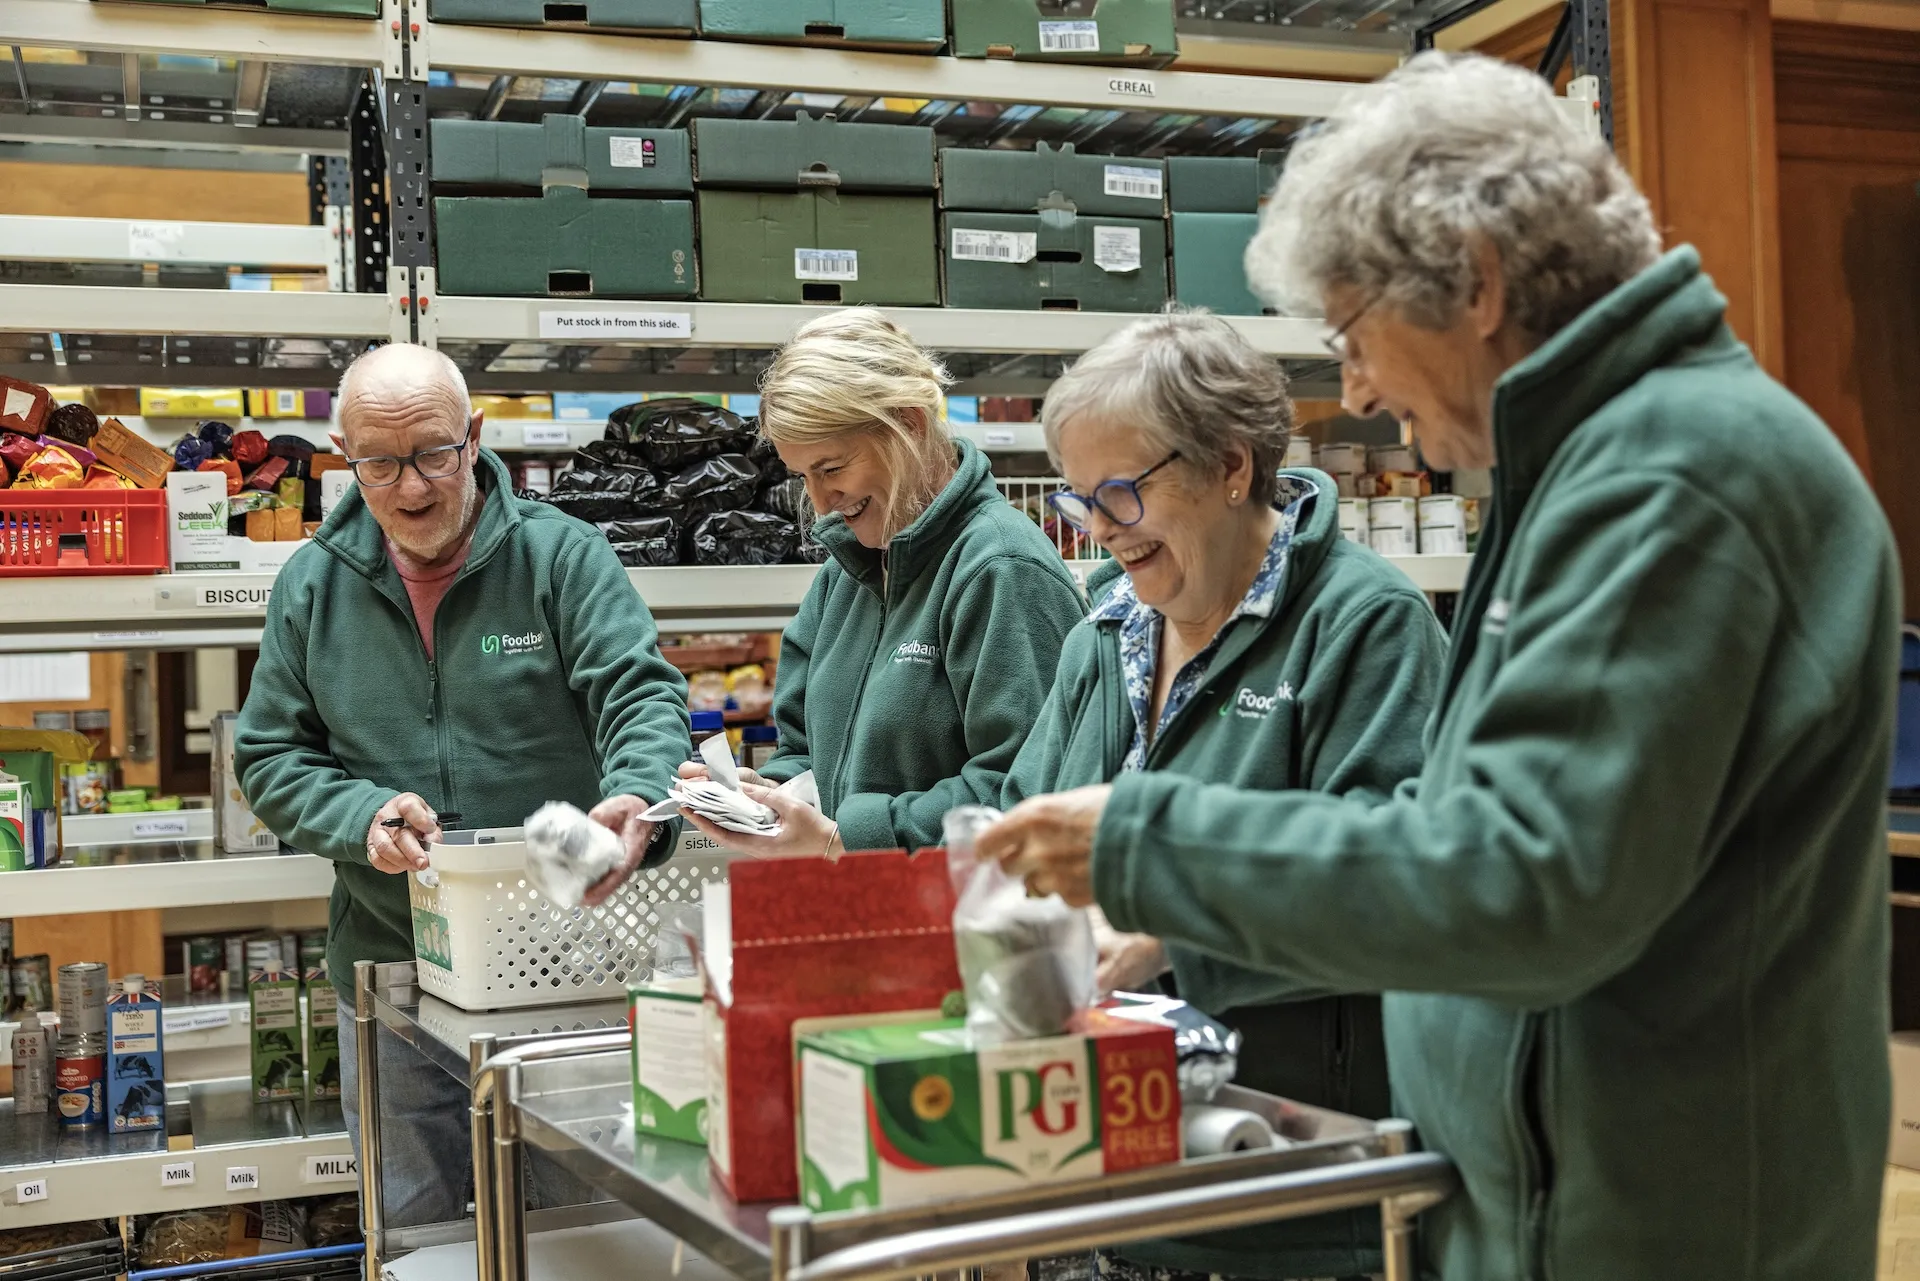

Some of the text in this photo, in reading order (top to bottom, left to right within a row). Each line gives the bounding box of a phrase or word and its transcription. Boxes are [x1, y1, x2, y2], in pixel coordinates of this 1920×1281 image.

[1109, 80, 1153, 95] CEREAL
[557, 317, 680, 329] Put stock in from this side.
[178, 511, 213, 521] Seddons
[205, 589, 272, 604] BISCUI
[502, 631, 544, 647] Foodba
[685, 836, 720, 850] siste
[995, 1060, 1078, 1142] PG
[1106, 1069, 1172, 1126] 30
[1109, 1124, 1174, 1154] FREE
[166, 1167, 191, 1181] Milk
[315, 1160, 358, 1176] MILK
[230, 1172, 255, 1185] Milk
[24, 1184, 40, 1197] Oil
